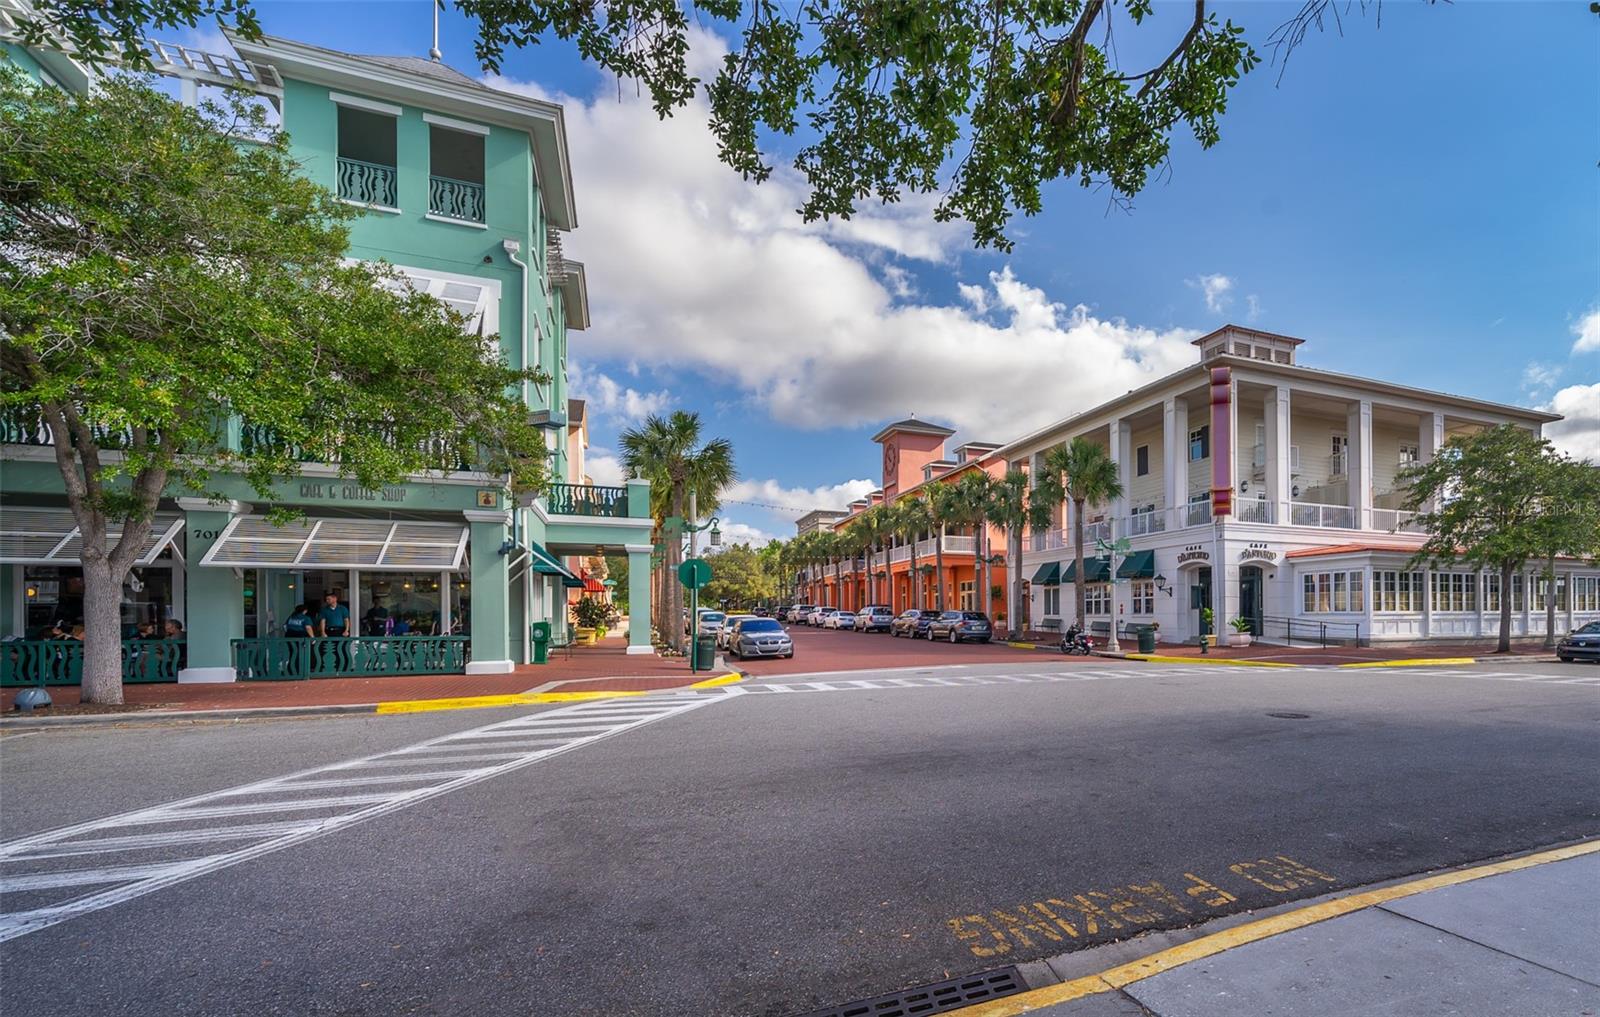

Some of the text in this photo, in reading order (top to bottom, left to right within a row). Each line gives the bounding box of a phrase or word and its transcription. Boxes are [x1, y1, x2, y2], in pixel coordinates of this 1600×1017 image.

[382, 487, 407, 502] SHOP
[193, 529, 219, 539] 701
[946, 872, 1237, 957] PARKING
